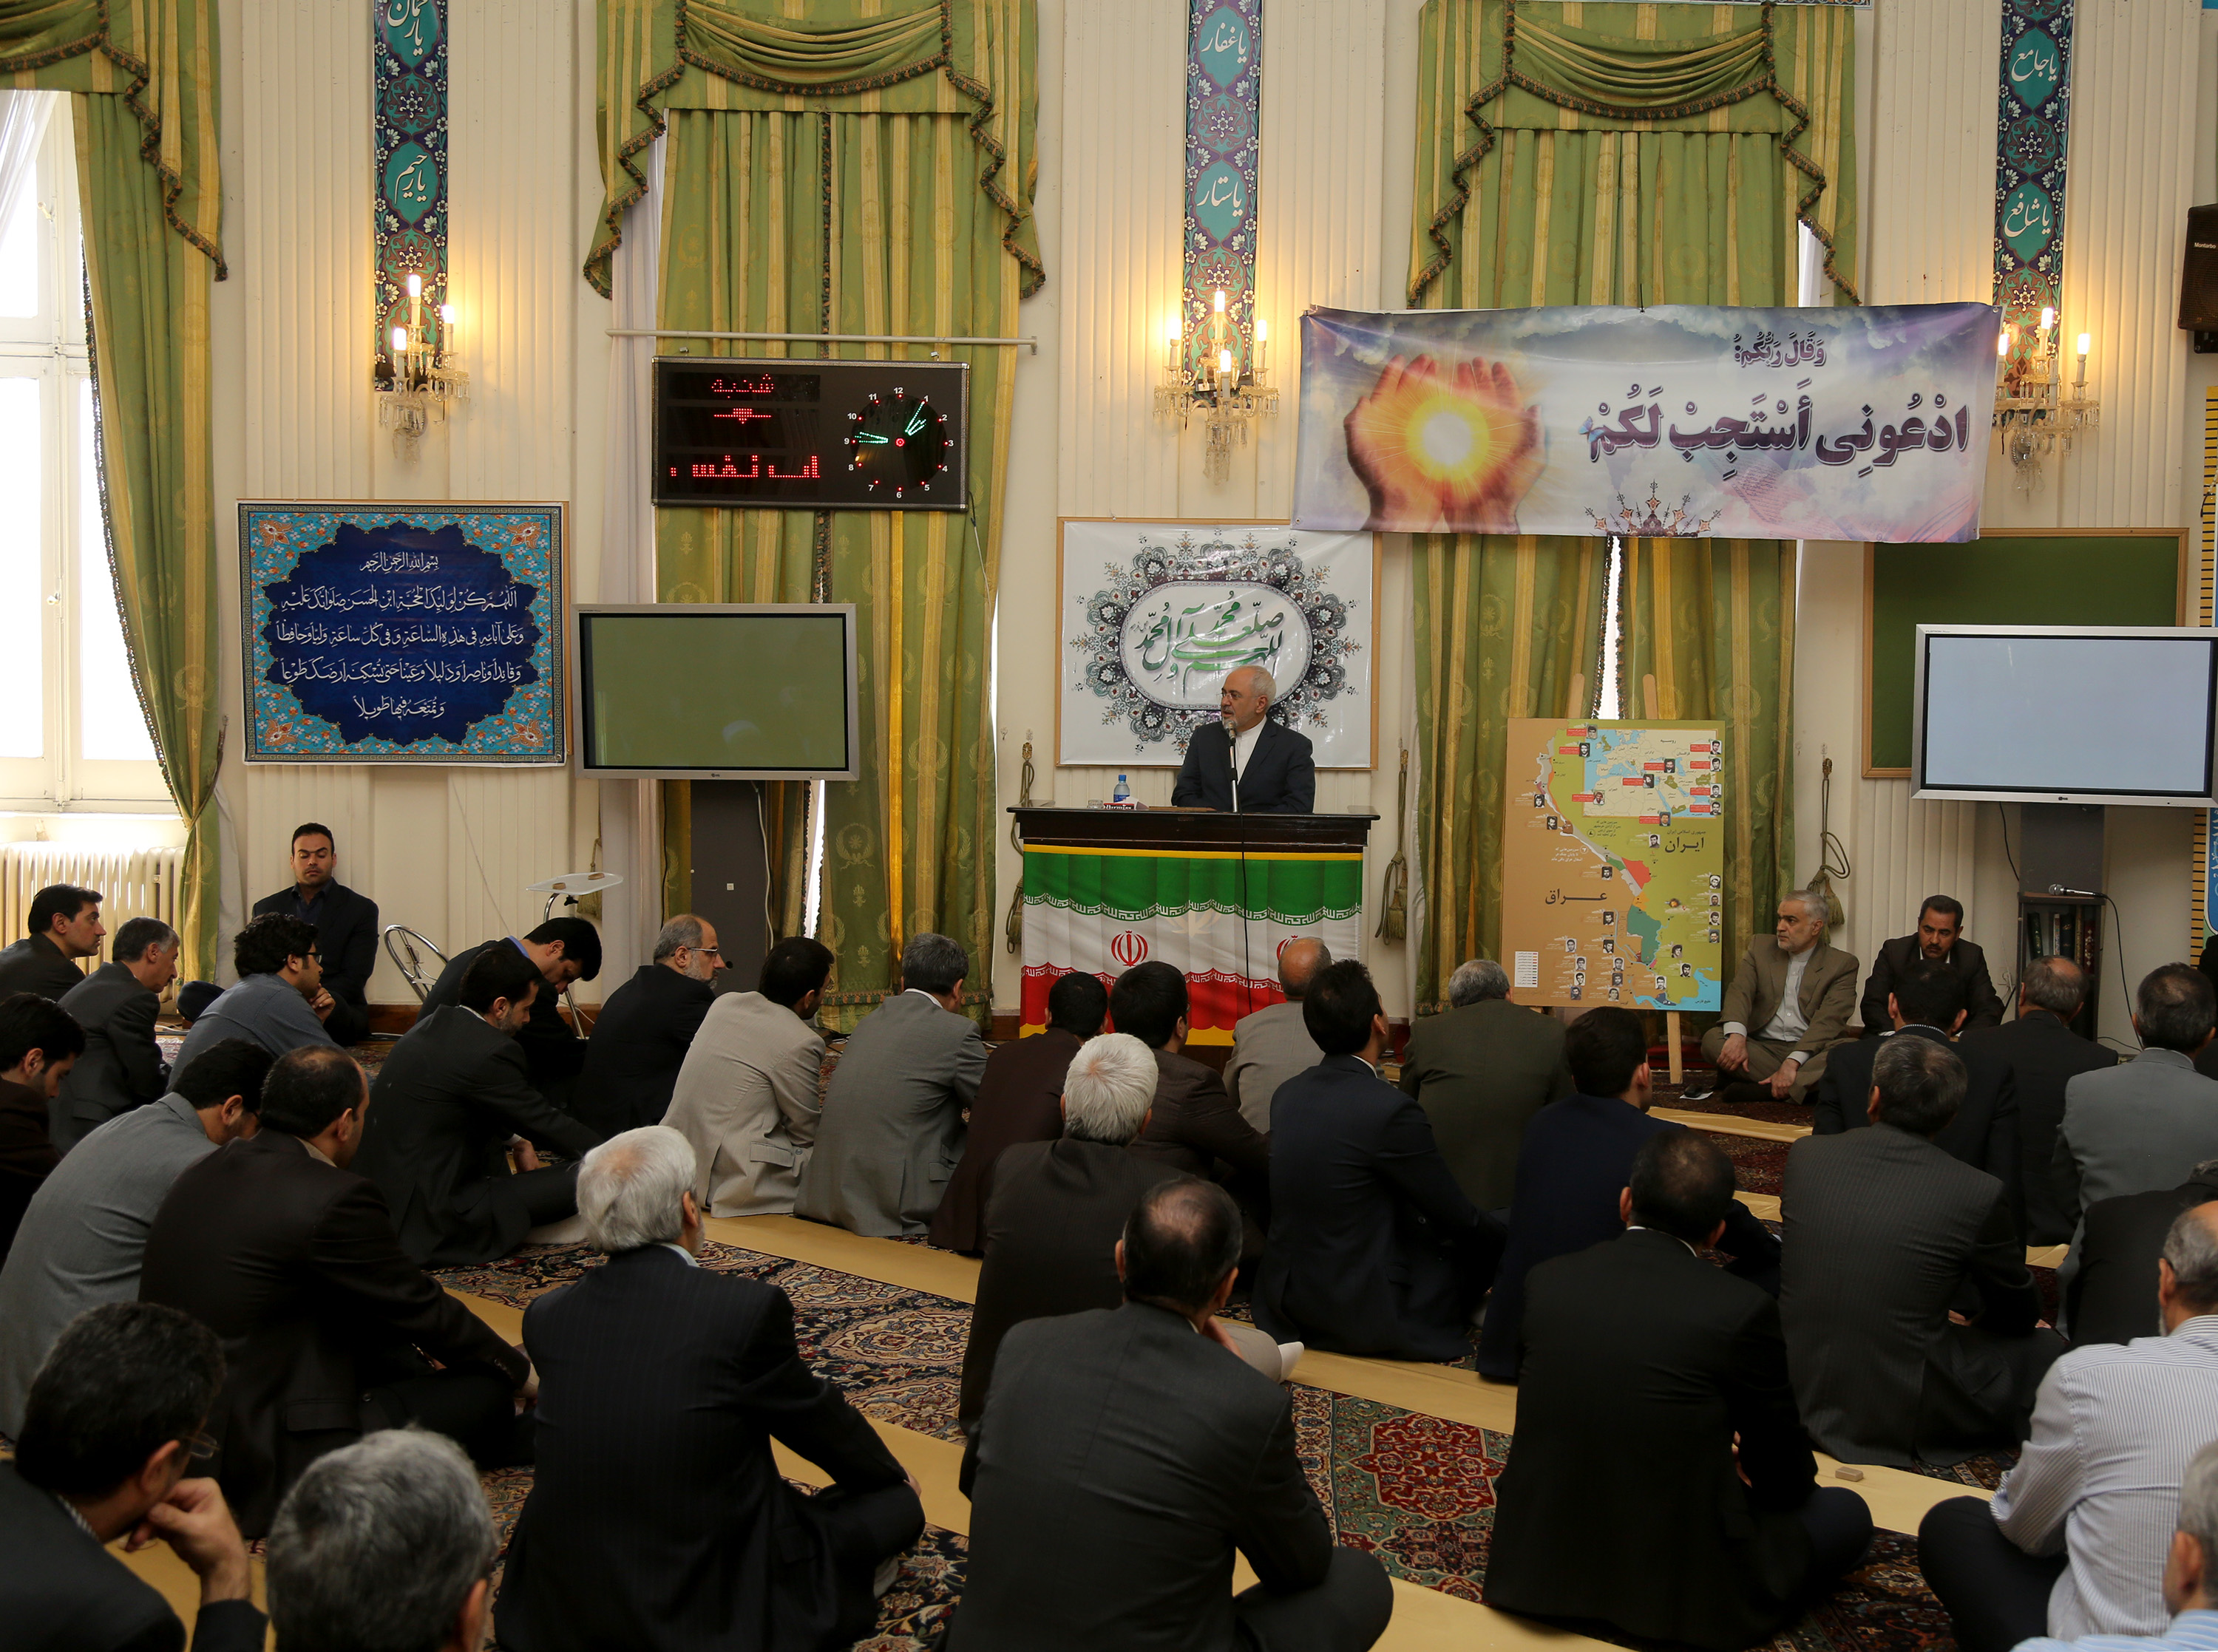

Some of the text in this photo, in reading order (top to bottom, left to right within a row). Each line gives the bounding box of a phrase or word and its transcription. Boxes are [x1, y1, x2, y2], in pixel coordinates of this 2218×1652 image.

[1201, 21, 1238, 52] غفار
[2011, 49, 2049, 82] جامع
[1196, 176, 1233, 207] ستار
[711, 373, 774, 398] شنبه
[868, 392, 878, 401] 11
[1664, 836, 1705, 854] ایران
[1544, 888, 1608, 905] عراق
